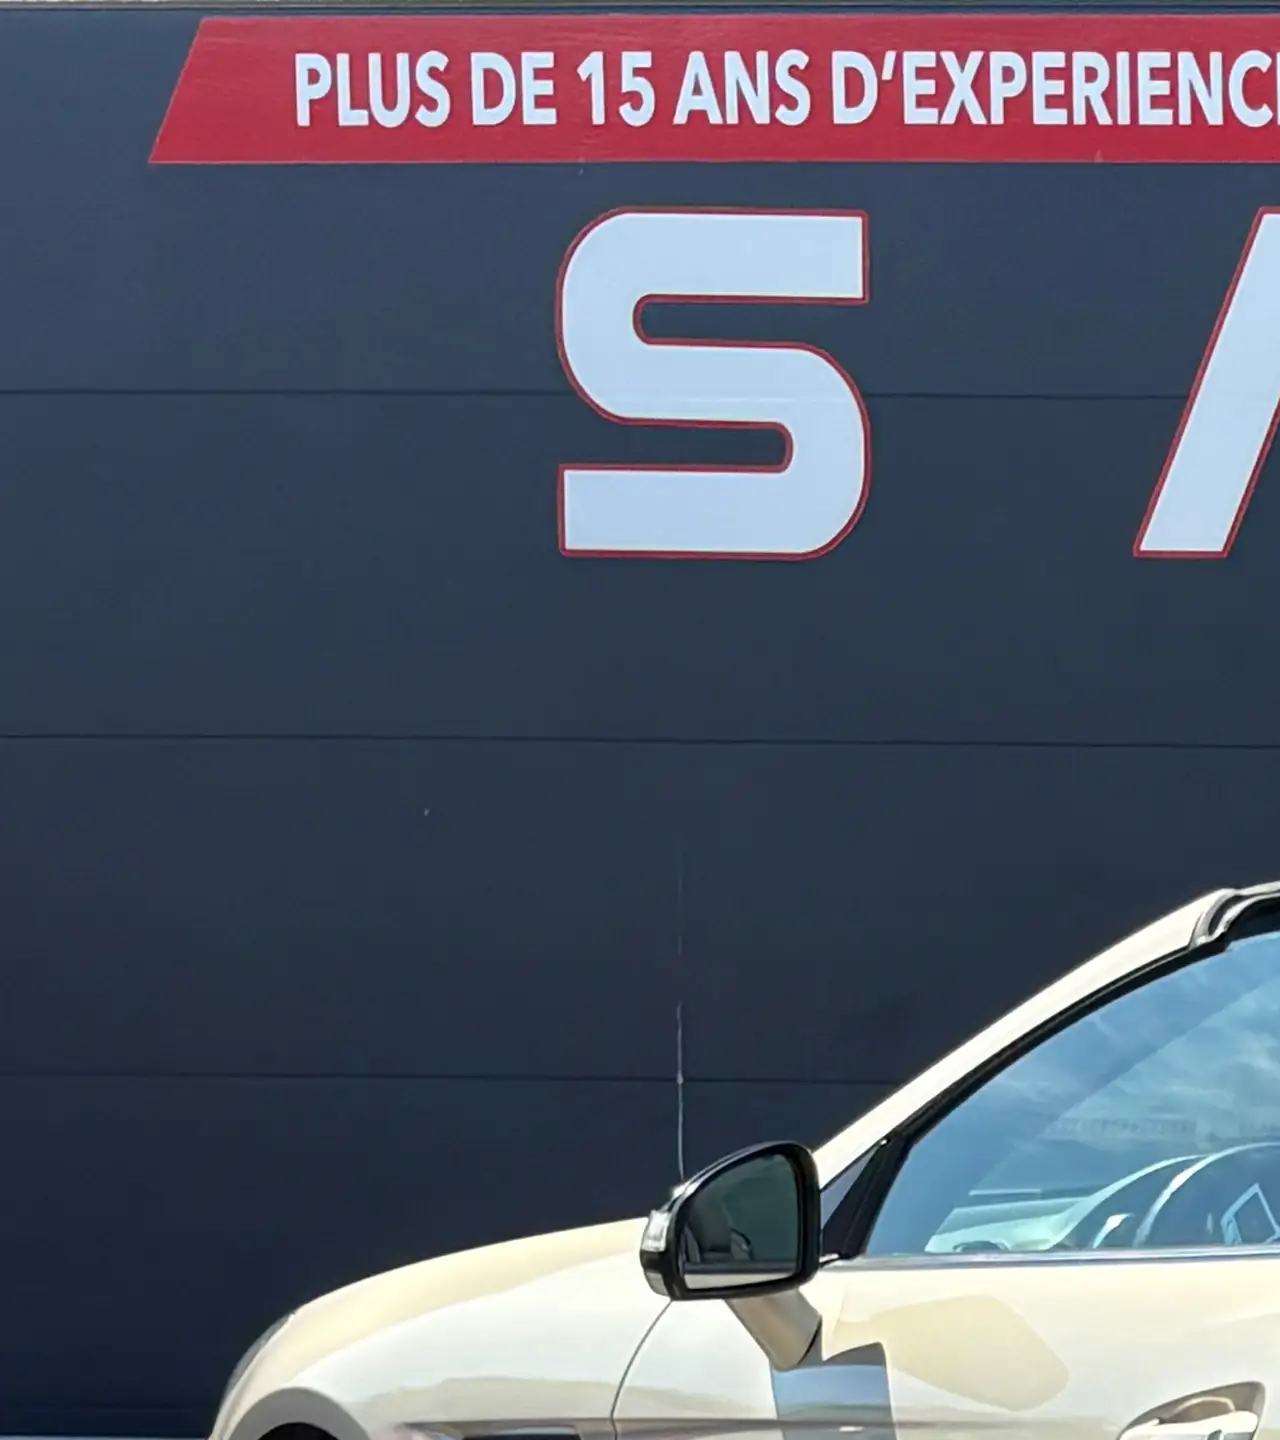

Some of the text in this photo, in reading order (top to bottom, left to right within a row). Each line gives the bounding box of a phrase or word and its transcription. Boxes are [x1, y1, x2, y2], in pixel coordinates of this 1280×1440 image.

[294, 49, 451, 129] PLUS
[470, 50, 558, 126] DE
[576, 50, 656, 127] 15
[672, 48, 811, 127] ANS
